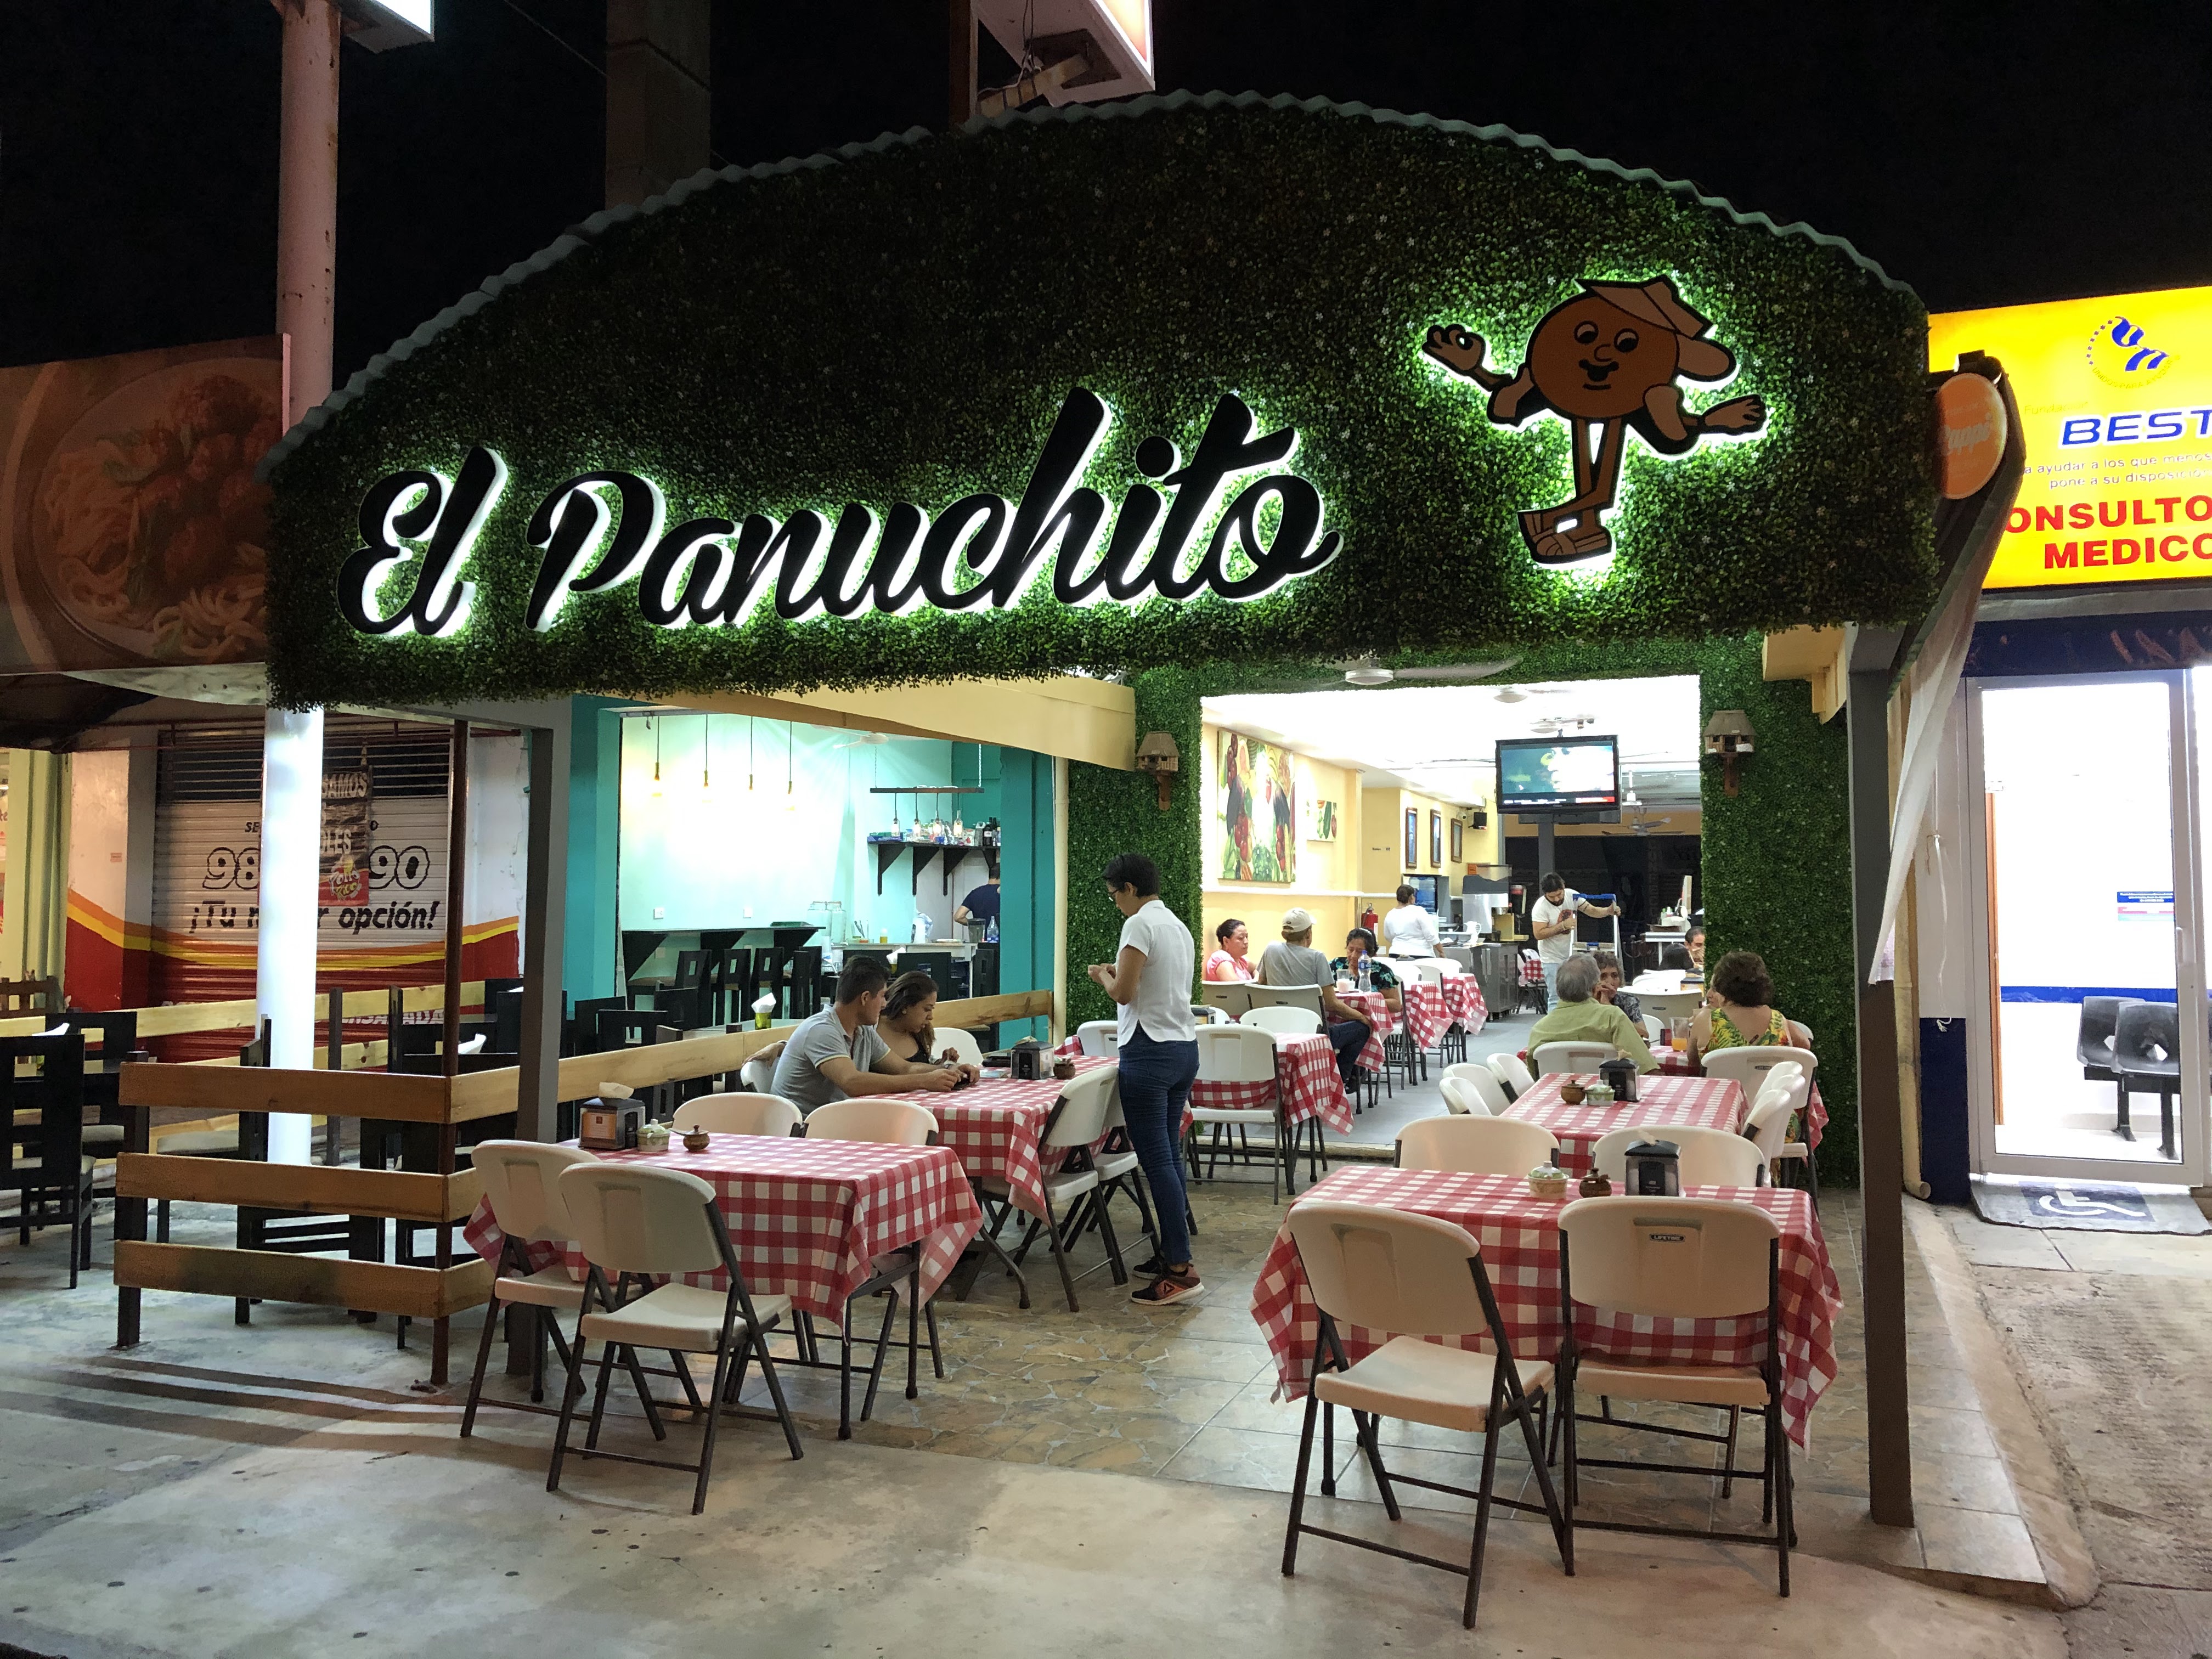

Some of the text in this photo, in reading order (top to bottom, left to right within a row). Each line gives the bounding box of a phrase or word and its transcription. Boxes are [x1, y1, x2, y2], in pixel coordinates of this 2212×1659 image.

[2061, 408, 2212, 446] BEST
[2037, 461, 2085, 475] ayudar
[2091, 461, 2099, 469] a
[2104, 459, 2125, 469] los
[2130, 457, 2157, 469] que
[2050, 478, 2085, 490] pone
[2103, 475, 2120, 484] su
[336, 385, 1344, 637] El Panuchito
[2045, 533, 2212, 569] MEDICO
[338, 901, 440, 935] opción!
